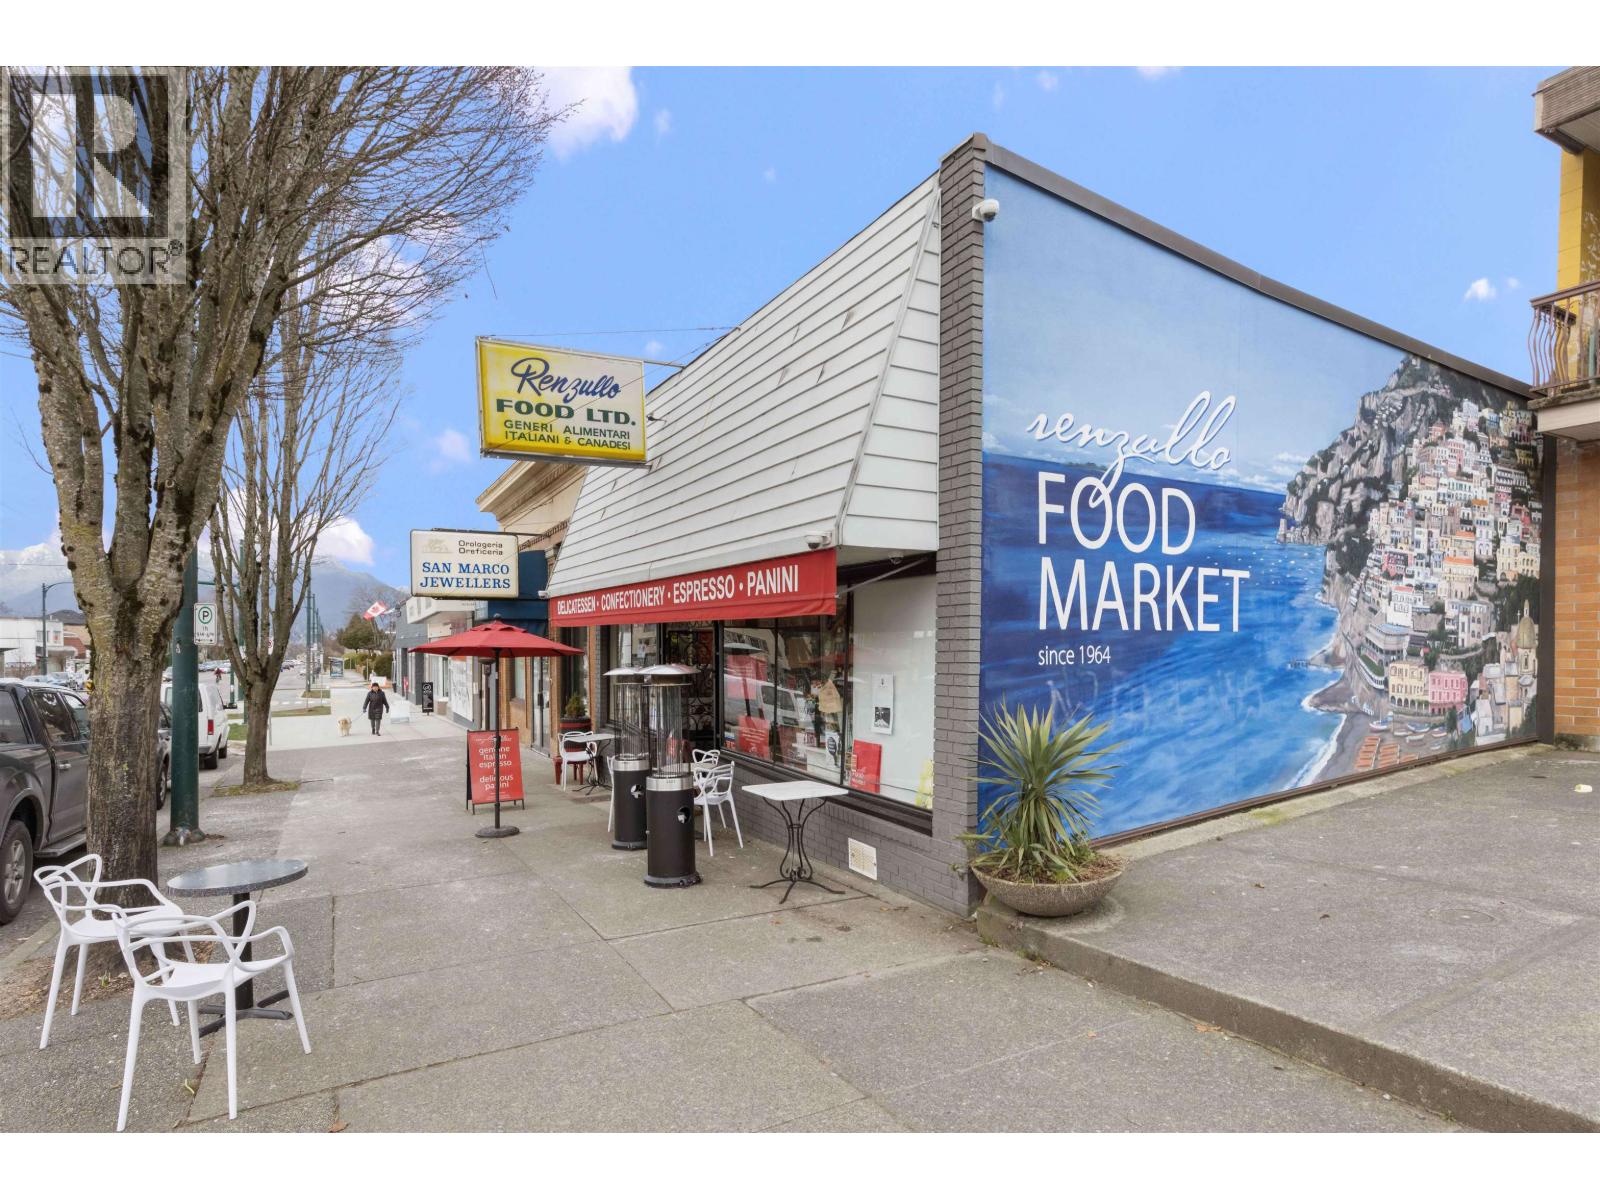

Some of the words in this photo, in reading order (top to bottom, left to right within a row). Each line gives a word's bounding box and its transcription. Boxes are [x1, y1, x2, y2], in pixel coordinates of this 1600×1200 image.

[510, 357, 622, 403] Renzullo
[496, 398, 575, 419] FOOD
[586, 408, 637, 426] LTD.
[503, 419, 553, 433] GENERI
[563, 425, 631, 440] ALIMENTARI
[504, 430, 559, 444] ITALIANI
[564, 437, 572, 445] &
[577, 437, 631, 450] CANADESI
[1026, 390, 1237, 509] renzullo
[1038, 471, 1196, 556] FOOD
[458, 540, 503, 549] Orologeria
[458, 547, 503, 555] Oreficeria
[422, 562, 452, 574] SAN
[458, 563, 510, 575] MARCO
[420, 576, 511, 589] JEWELLERS
[557, 595, 596, 615] DELICATESSEN
[601, 585, 665, 612] CONFECTIONERY
[673, 574, 735, 604] ESPRESSO
[747, 564, 799, 597] PANINI
[1038, 556, 1250, 633] MARKET
[1038, 645, 1075, 666] since
[1080, 645, 1111, 665] 1964
[479, 760, 512, 768] esprsso
[479, 774, 513, 783] delious
[485, 781, 509, 790] paini
